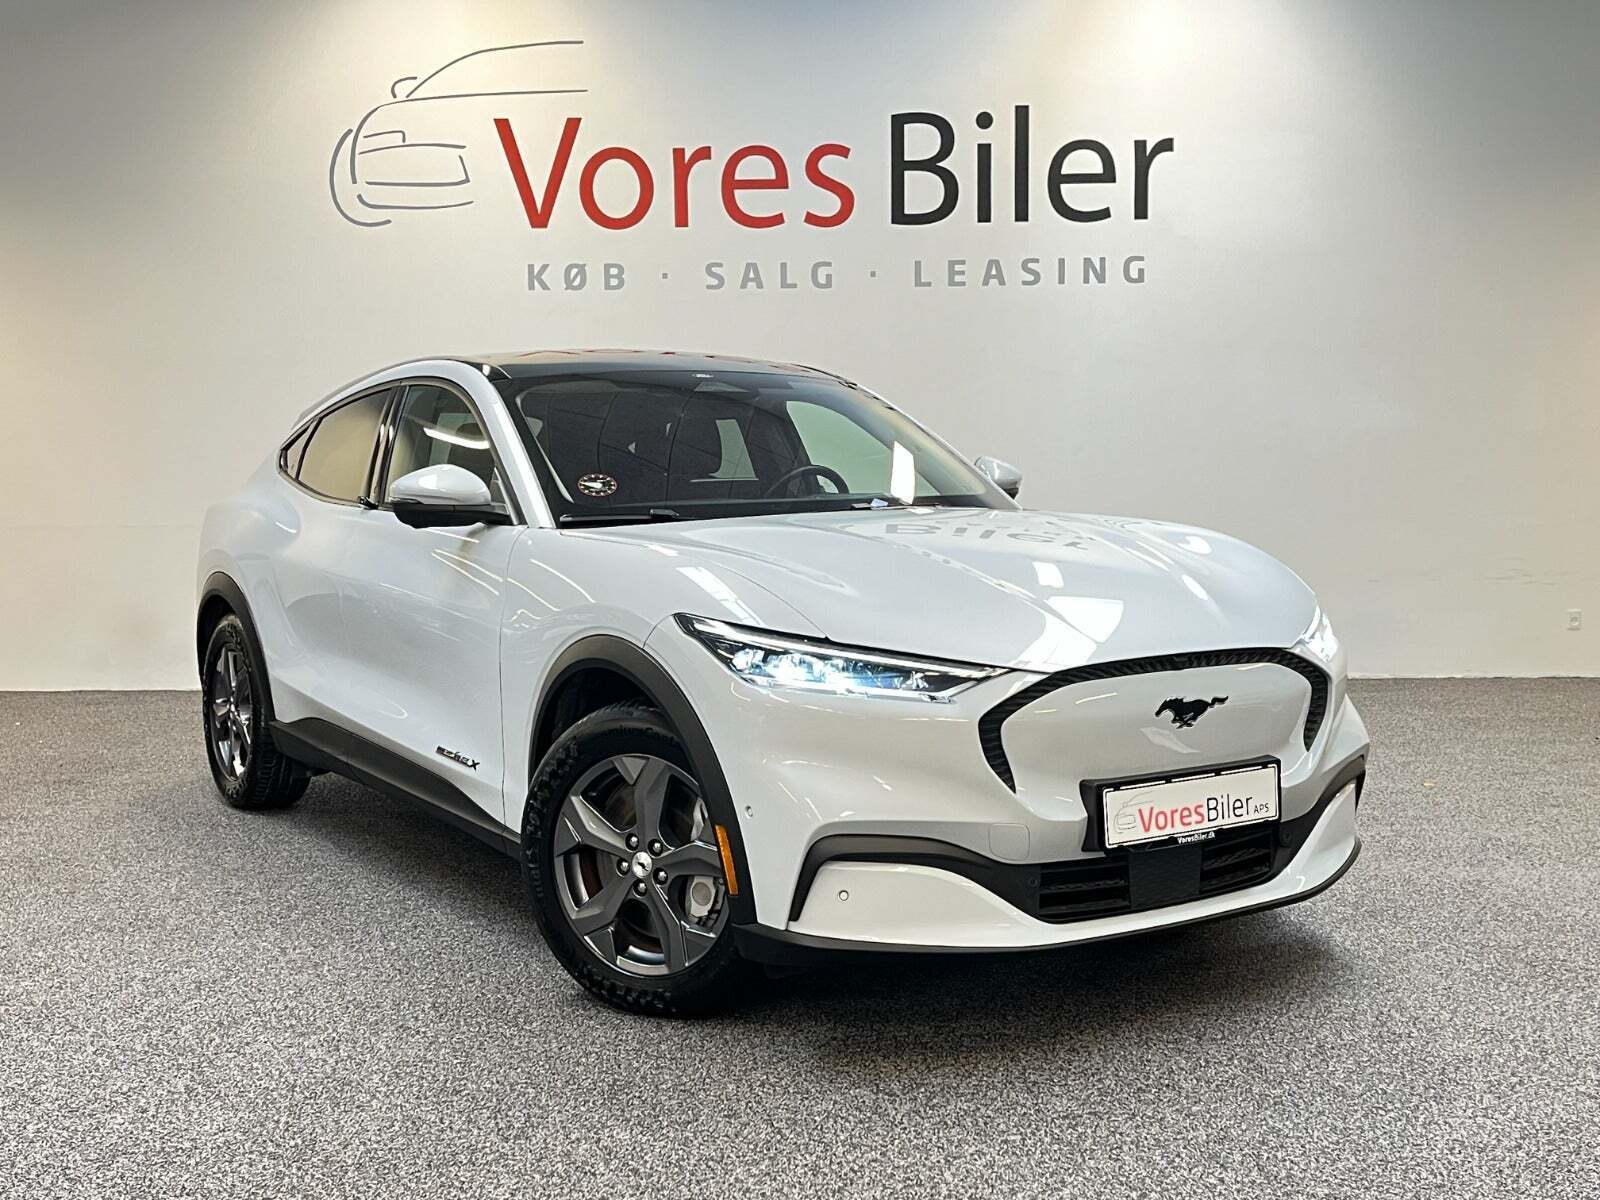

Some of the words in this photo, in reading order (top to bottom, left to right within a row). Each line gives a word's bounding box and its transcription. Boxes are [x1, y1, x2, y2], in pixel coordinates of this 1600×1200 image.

[494, 117, 855, 230] Vores
[890, 105, 1175, 226] Biler
[527, 263, 626, 291] KØB
[704, 260, 834, 290] SALG
[913, 255, 1147, 288] LEASING
